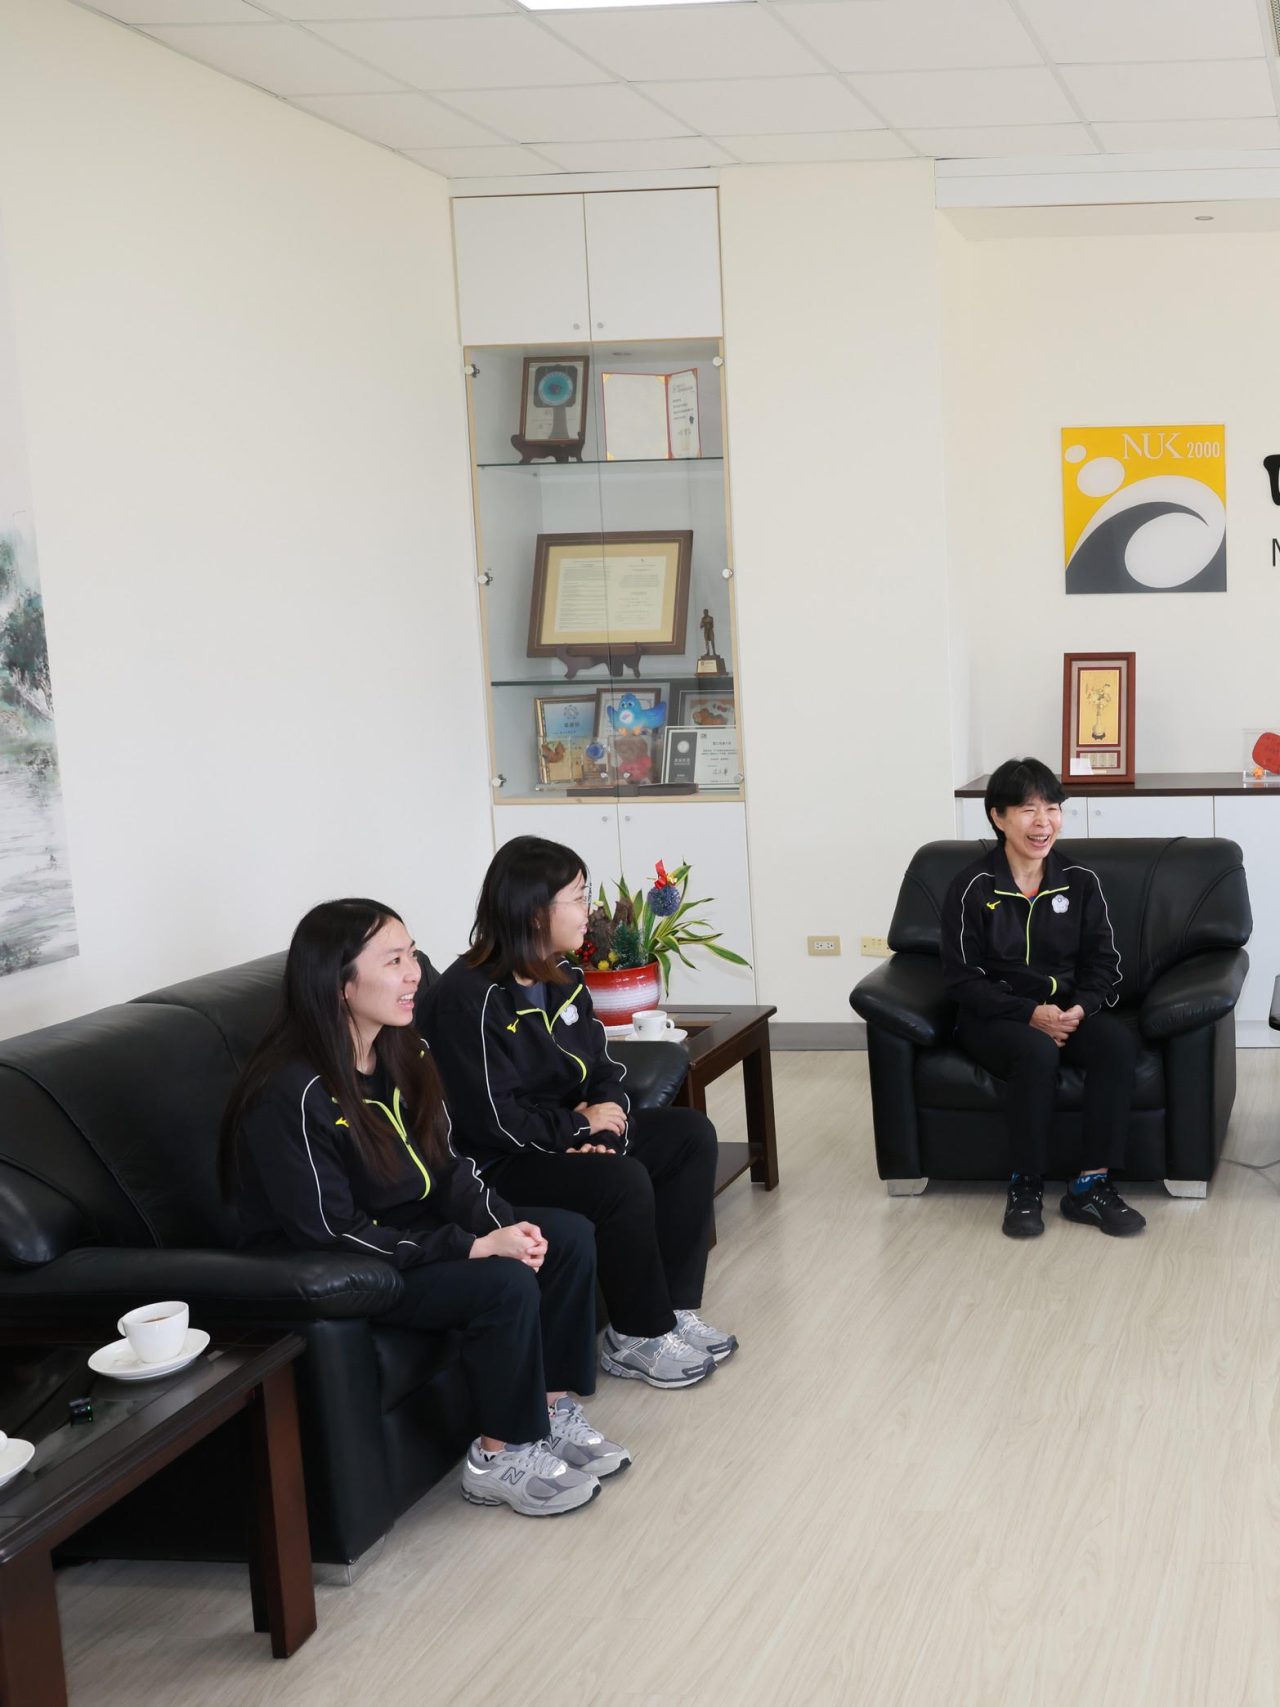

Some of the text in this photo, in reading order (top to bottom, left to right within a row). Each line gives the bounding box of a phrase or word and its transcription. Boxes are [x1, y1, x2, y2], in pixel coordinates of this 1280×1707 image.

[1121, 431, 1221, 460] NUK 2000
[500, 1466, 526, 1485] N
